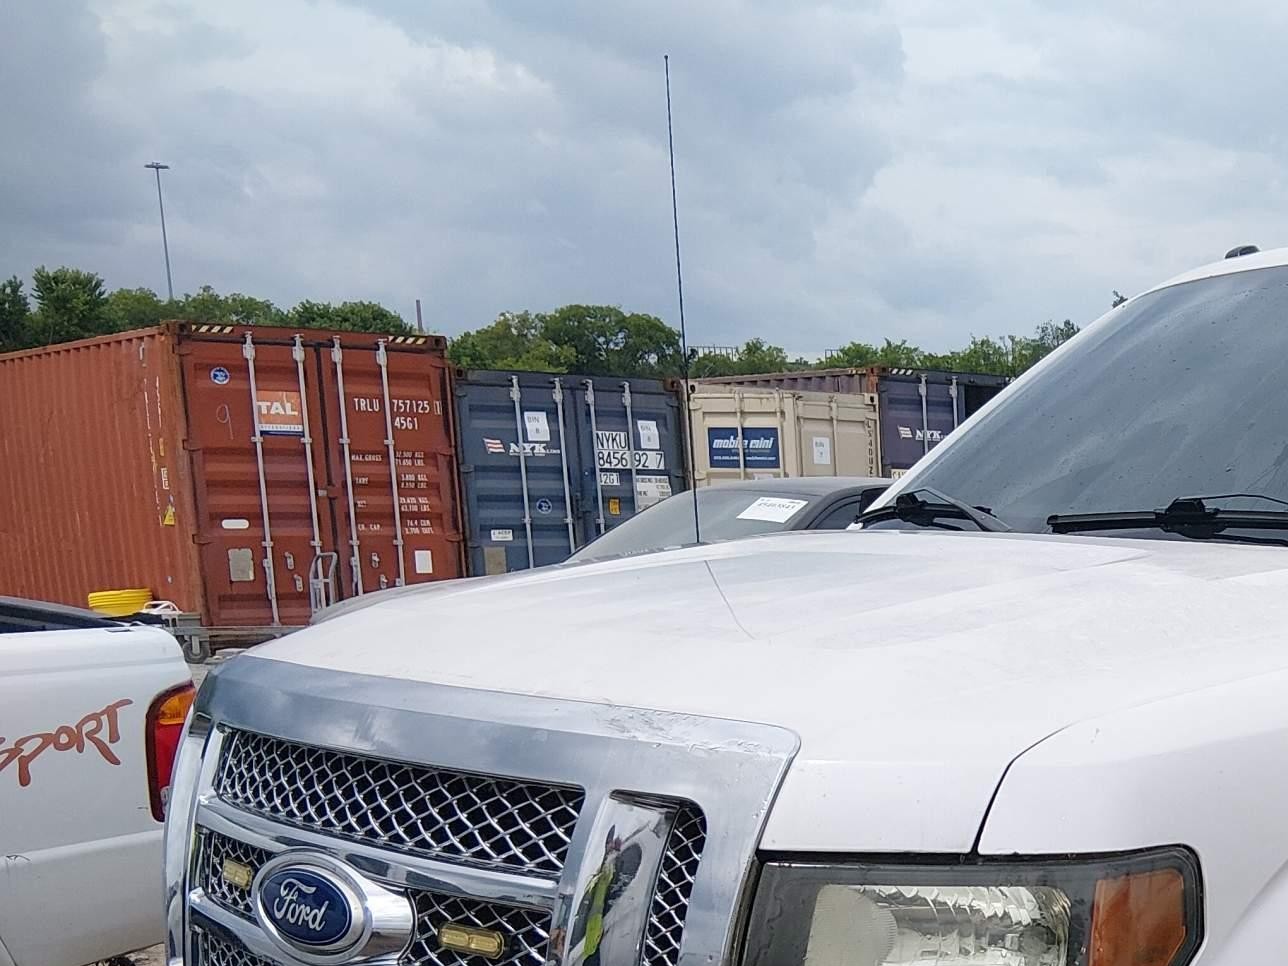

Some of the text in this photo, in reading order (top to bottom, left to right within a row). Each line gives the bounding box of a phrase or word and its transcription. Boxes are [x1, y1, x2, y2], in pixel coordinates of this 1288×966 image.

[256, 401, 299, 415] TAL
[353, 398, 380, 412] TRLU
[391, 399, 430, 413] 757125
[509, 443, 547, 453] NYK
[597, 433, 627, 449] NYKU
[749, 437, 776, 449] mini
[273, 878, 330, 931] Ford
